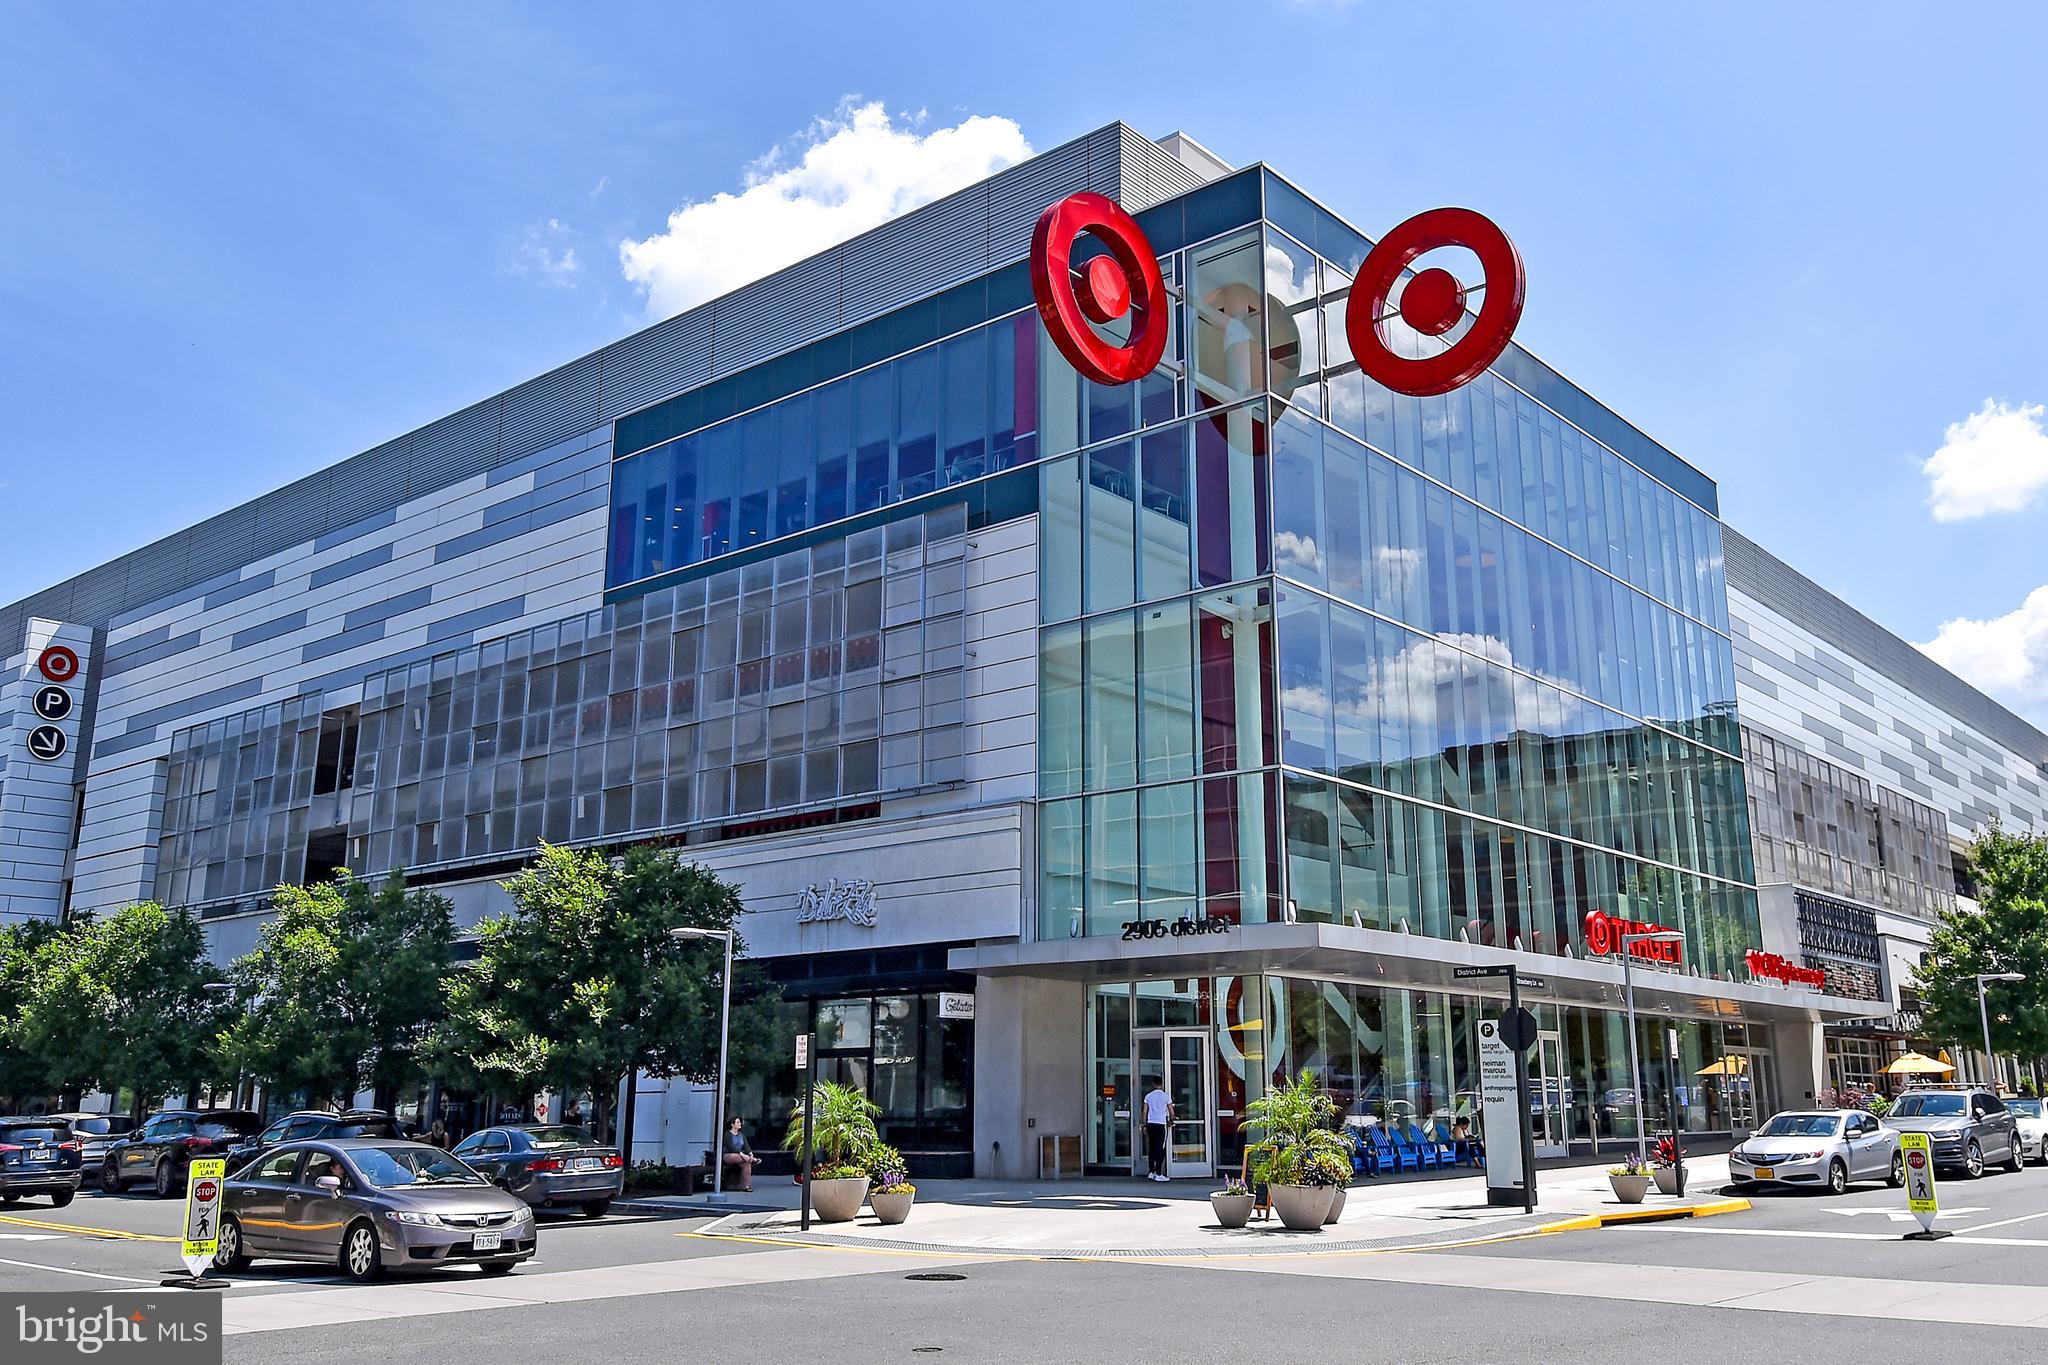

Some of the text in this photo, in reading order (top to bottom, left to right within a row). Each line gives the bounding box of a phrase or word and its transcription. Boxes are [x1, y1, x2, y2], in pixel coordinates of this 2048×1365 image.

[45, 693, 62, 711] P
[1457, 968, 1476, 976] District
[1481, 1042, 1500, 1051] target
[1484, 1096, 1505, 1104] requin
[1908, 1156, 1925, 1164] STOP
[196, 1187, 216, 1197] STOP
